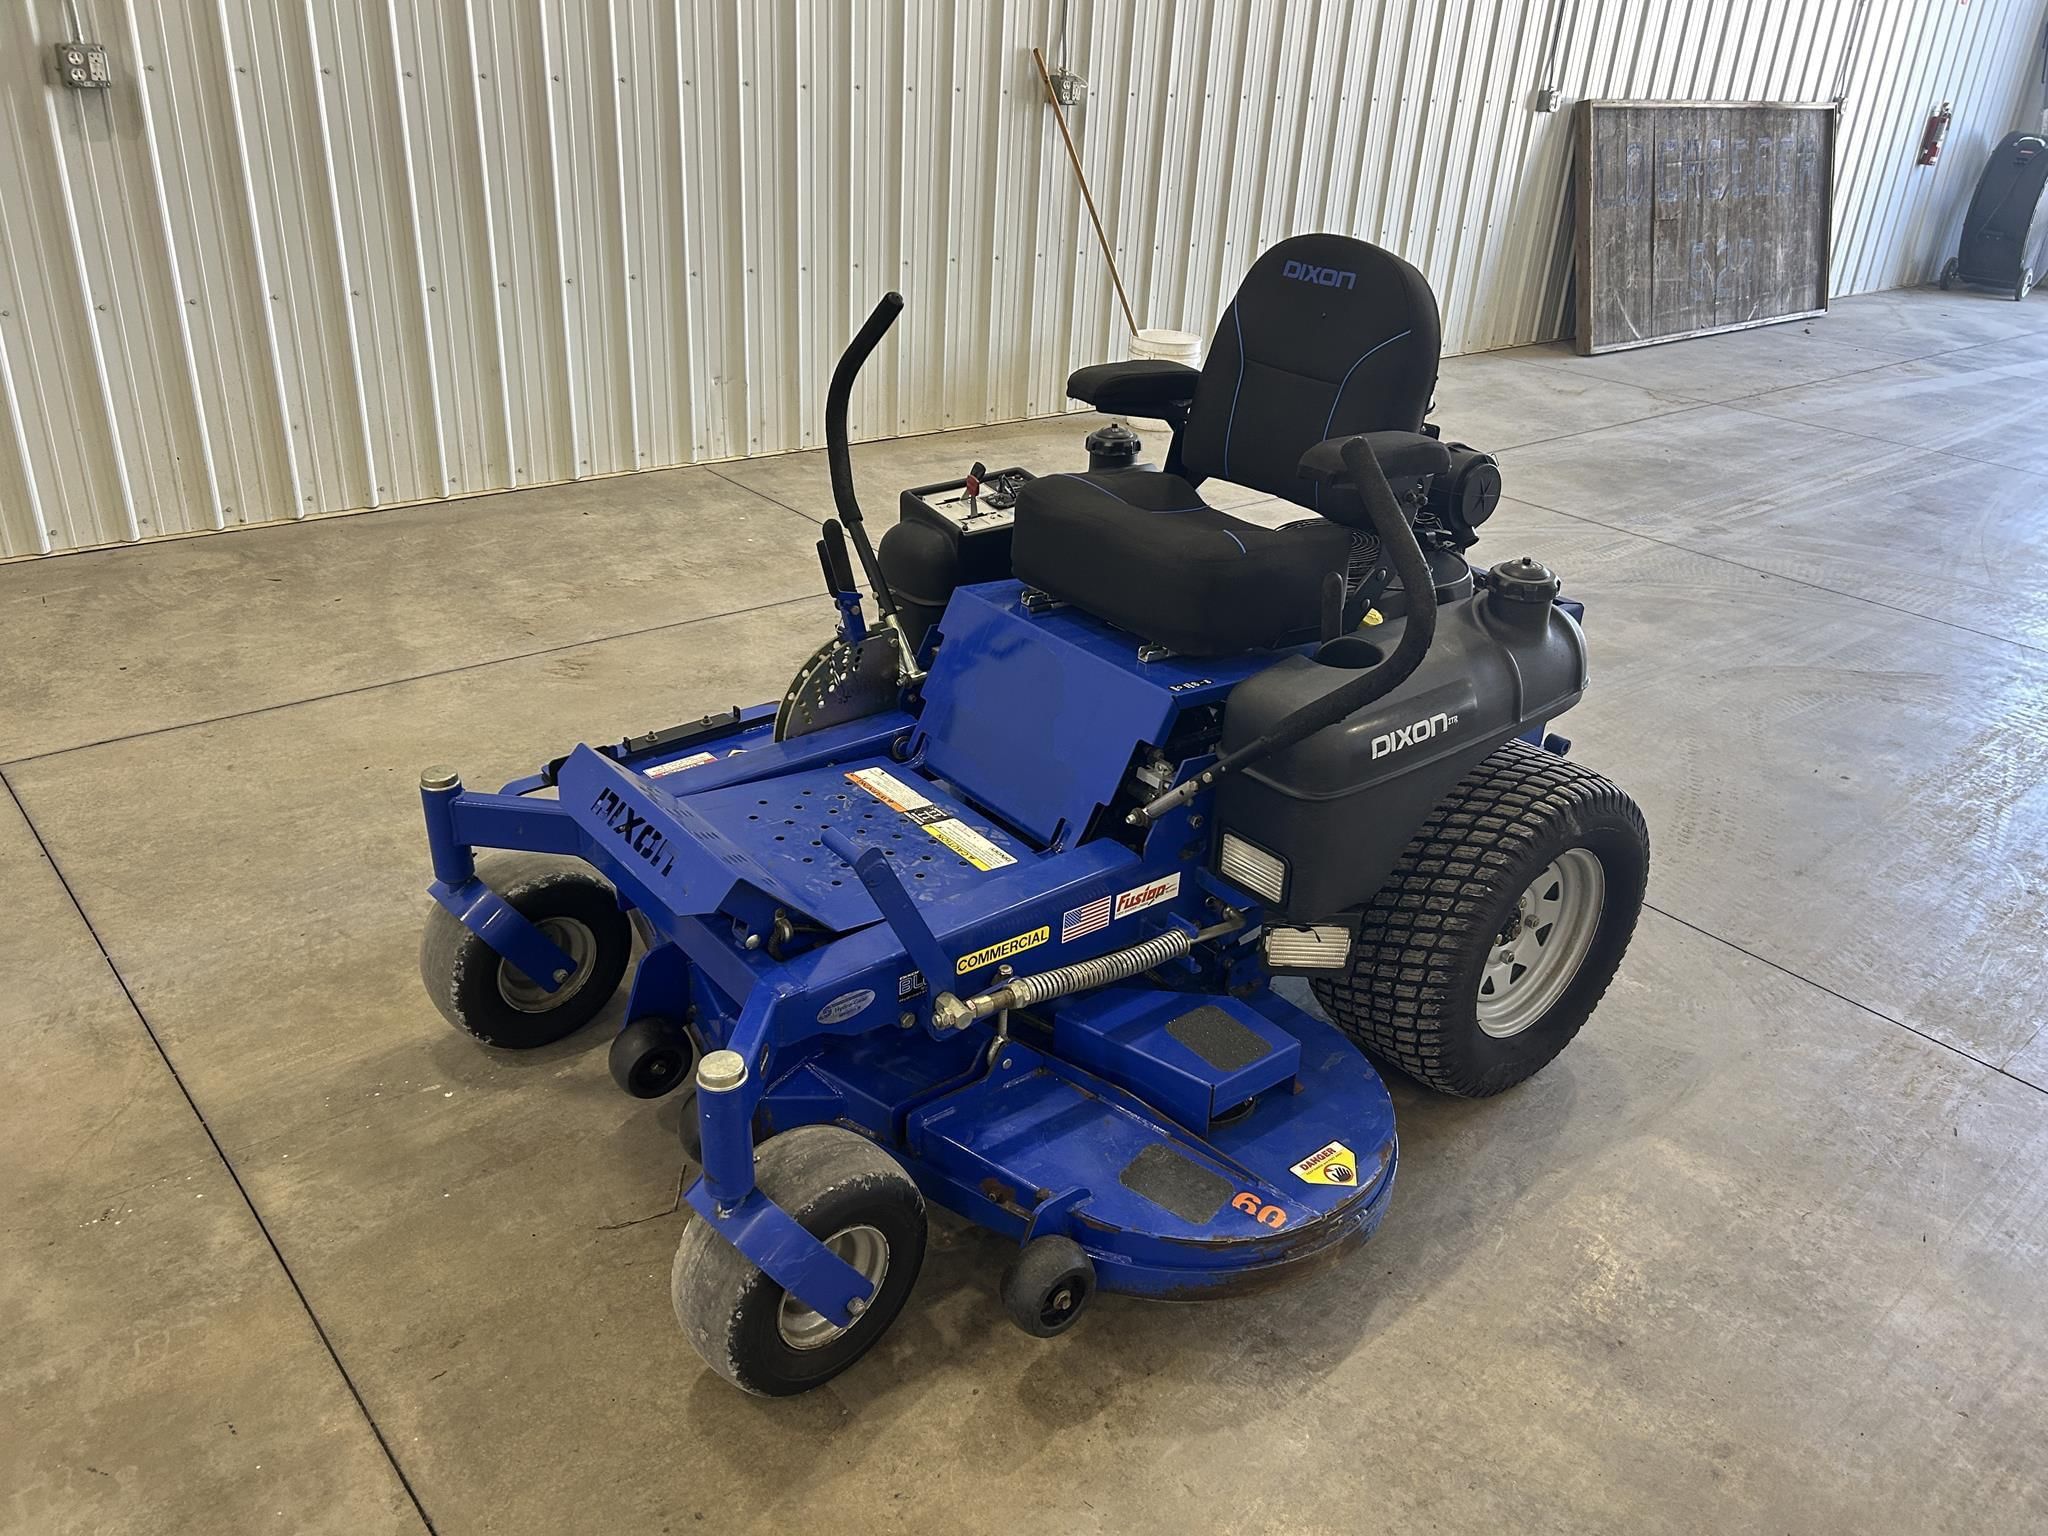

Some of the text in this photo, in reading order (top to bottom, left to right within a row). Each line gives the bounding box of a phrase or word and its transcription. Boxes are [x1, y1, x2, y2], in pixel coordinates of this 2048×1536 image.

[1282, 259, 1357, 290] DIXON
[1371, 713, 1448, 760] DIXON
[590, 786, 675, 878] DIXON
[1116, 884, 1167, 912] Fusion
[957, 929, 1048, 972] COMMERCIAL
[899, 974, 927, 996] BL
[1300, 1147, 1337, 1171] DANGER
[1231, 1191, 1287, 1229] 60
